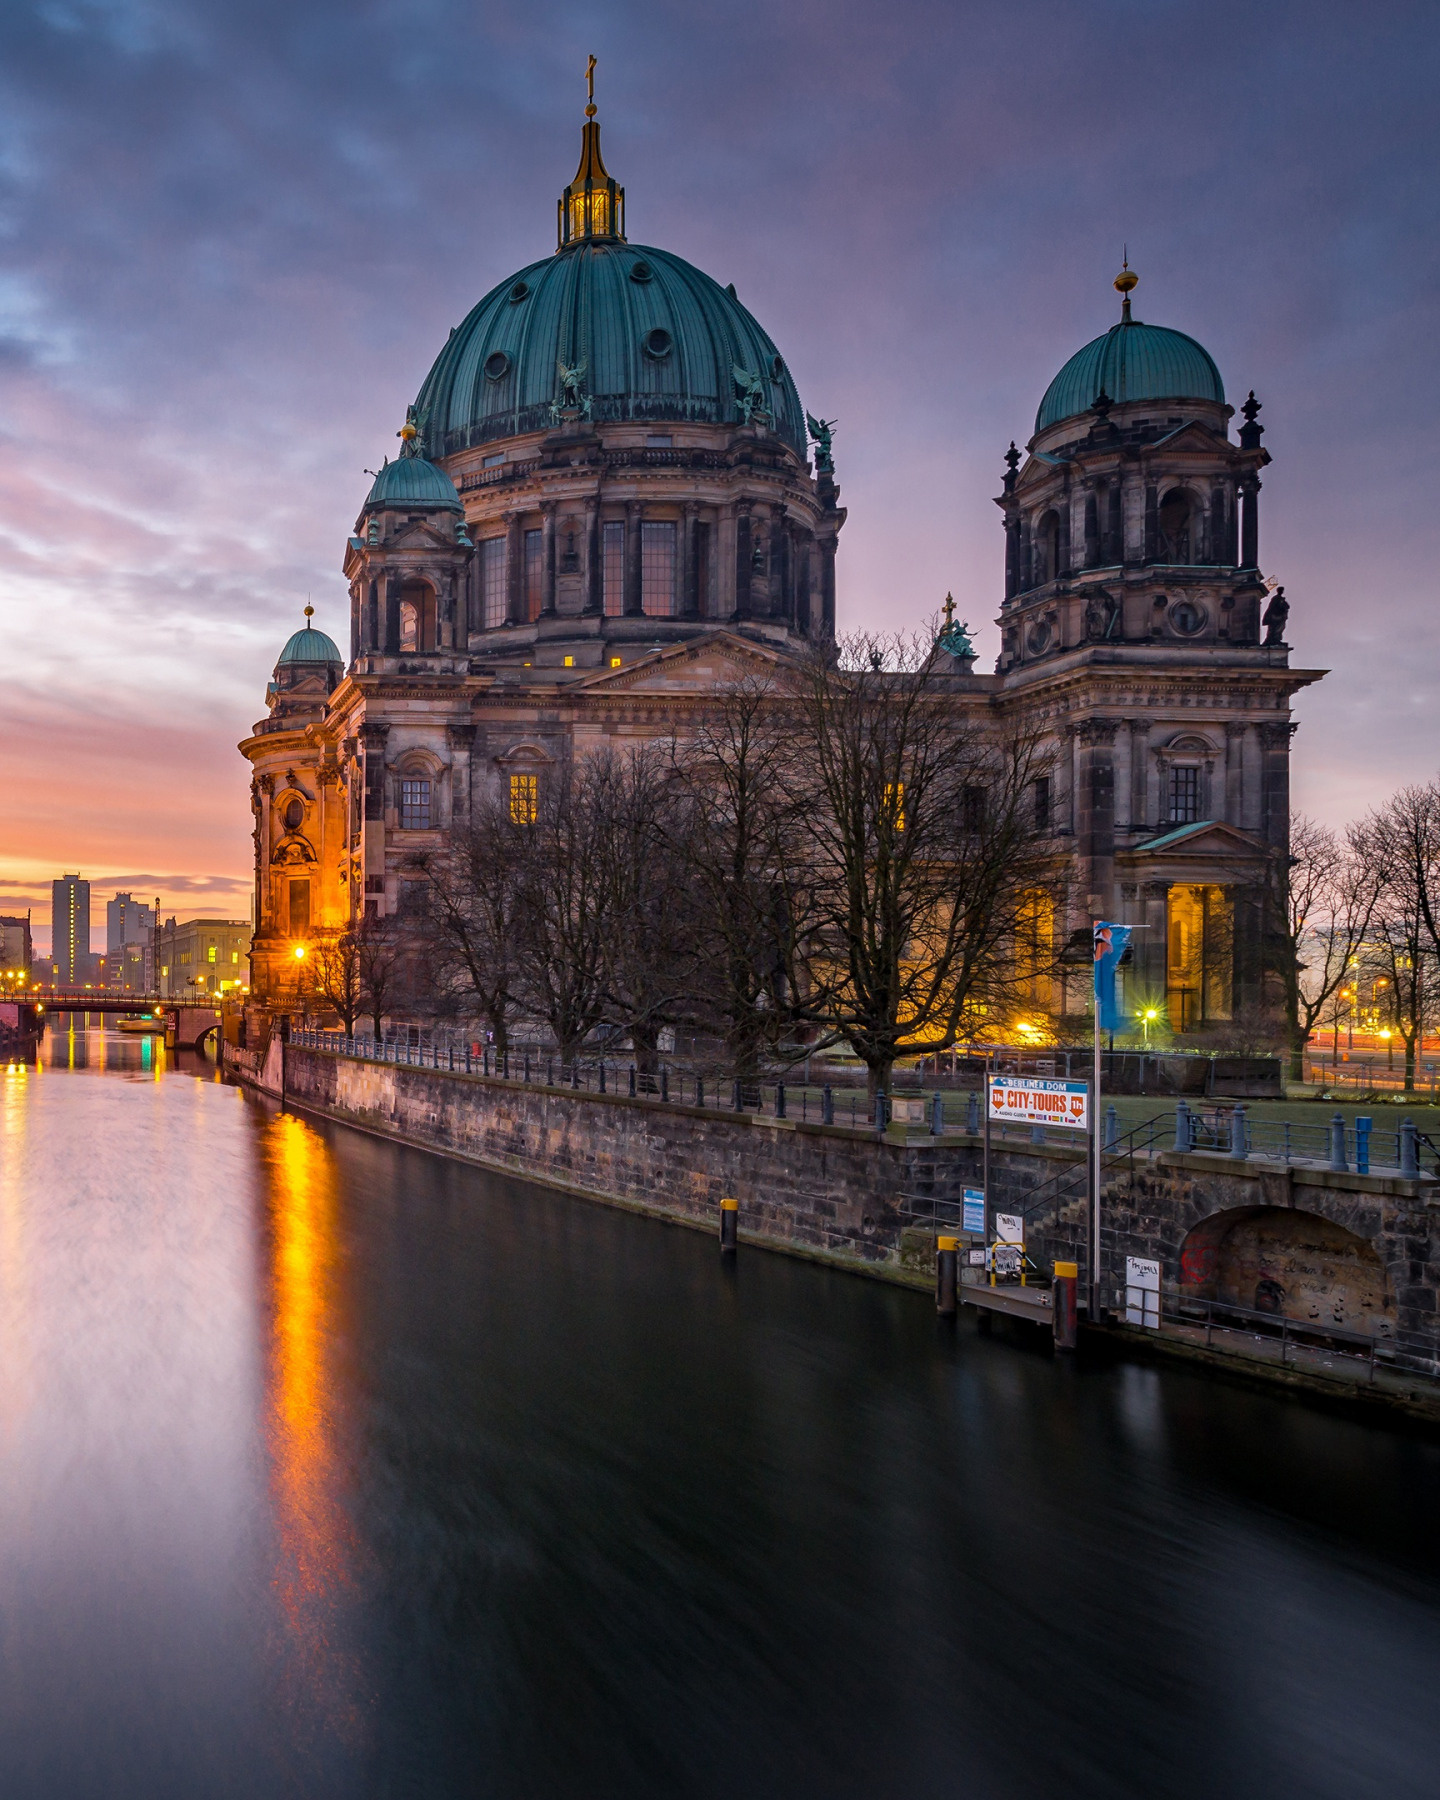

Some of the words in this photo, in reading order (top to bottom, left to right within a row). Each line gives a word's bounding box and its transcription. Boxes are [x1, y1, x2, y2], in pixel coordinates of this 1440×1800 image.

[1008, 1079, 1044, 1089] BERLINER
[1046, 1082, 1067, 1091] DOM
[993, 1093, 1003, 1102] 1h
[1008, 1090, 1067, 1113] CITY-TOURS
[1071, 1100, 1082, 1109] 1h
